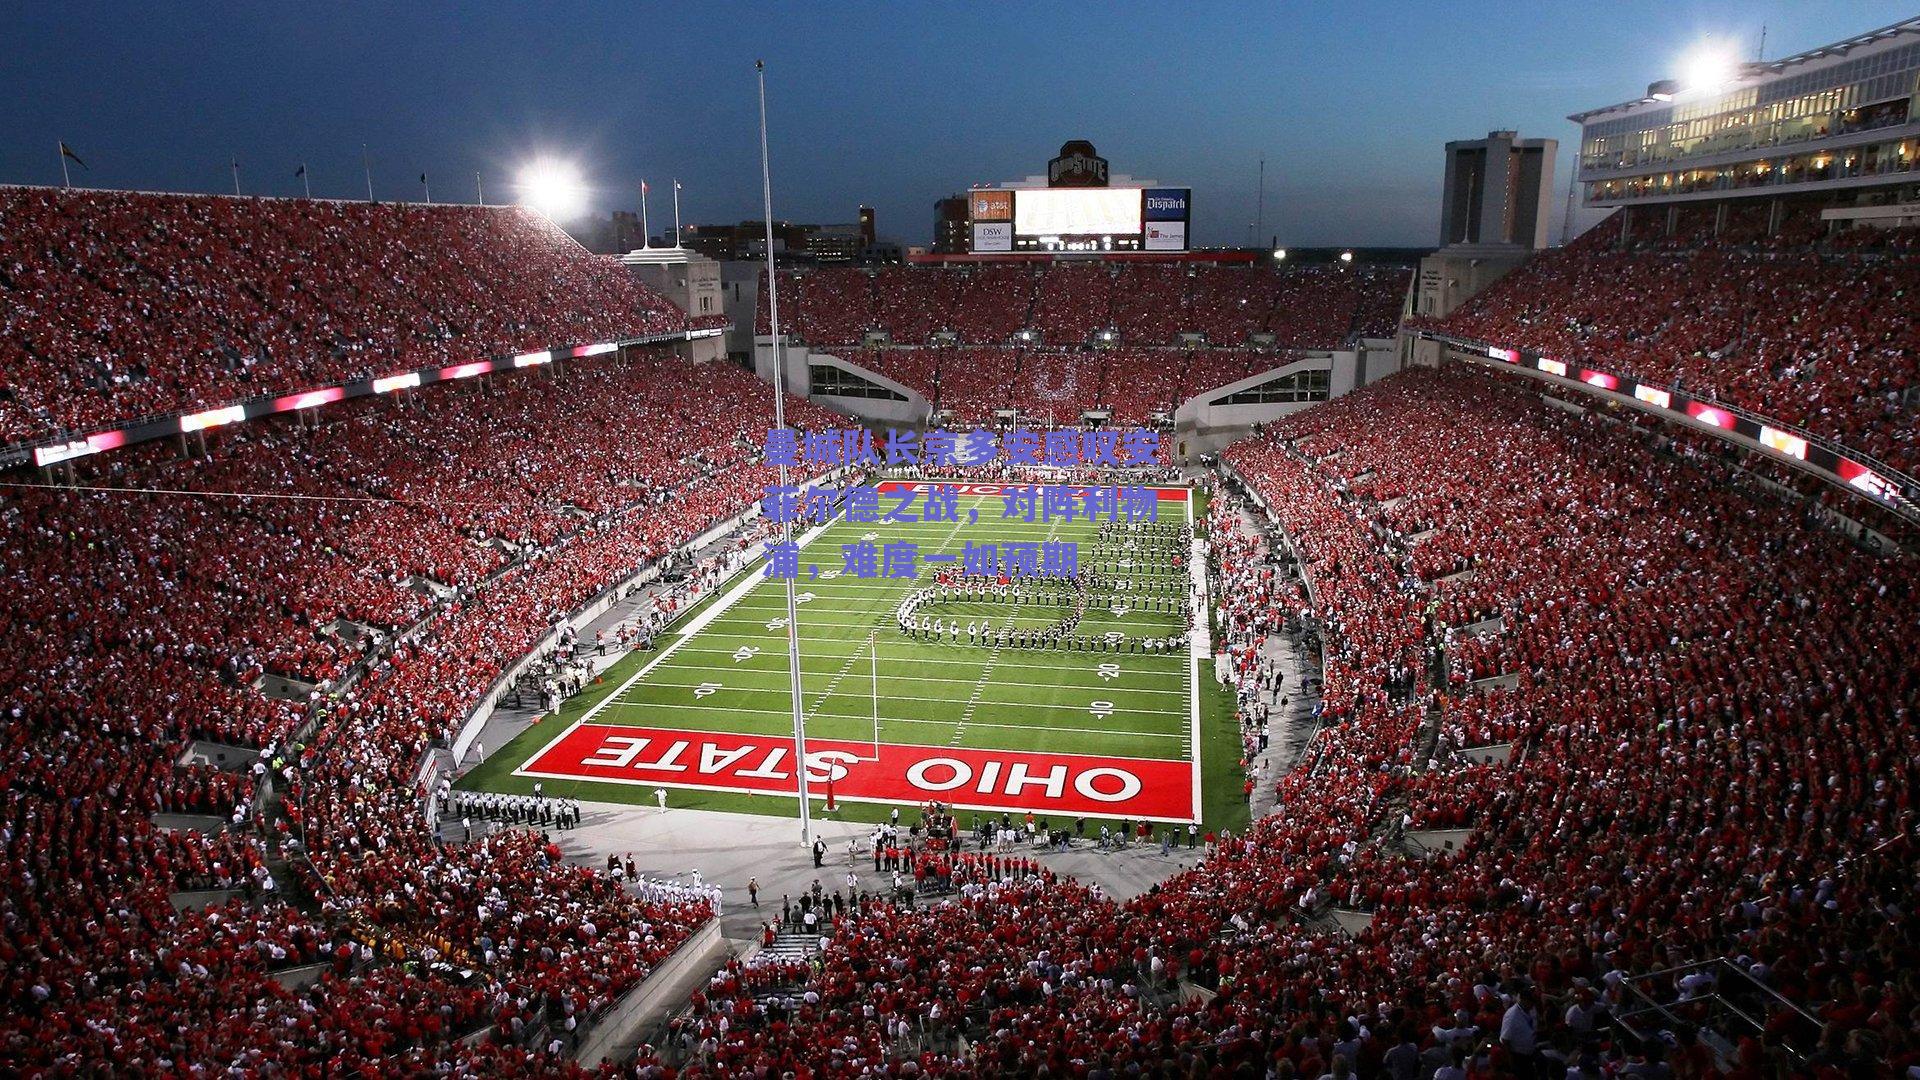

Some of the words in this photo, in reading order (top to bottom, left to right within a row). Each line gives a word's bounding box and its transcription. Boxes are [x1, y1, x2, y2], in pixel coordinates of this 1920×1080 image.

[1147, 197, 1185, 210] Dispatch
[983, 228, 1002, 236] DSW
[1097, 663, 1120, 678] 20
[1089, 701, 1114, 715] 10
[580, 736, 859, 783] STATE
[905, 757, 1142, 802] OHIO
